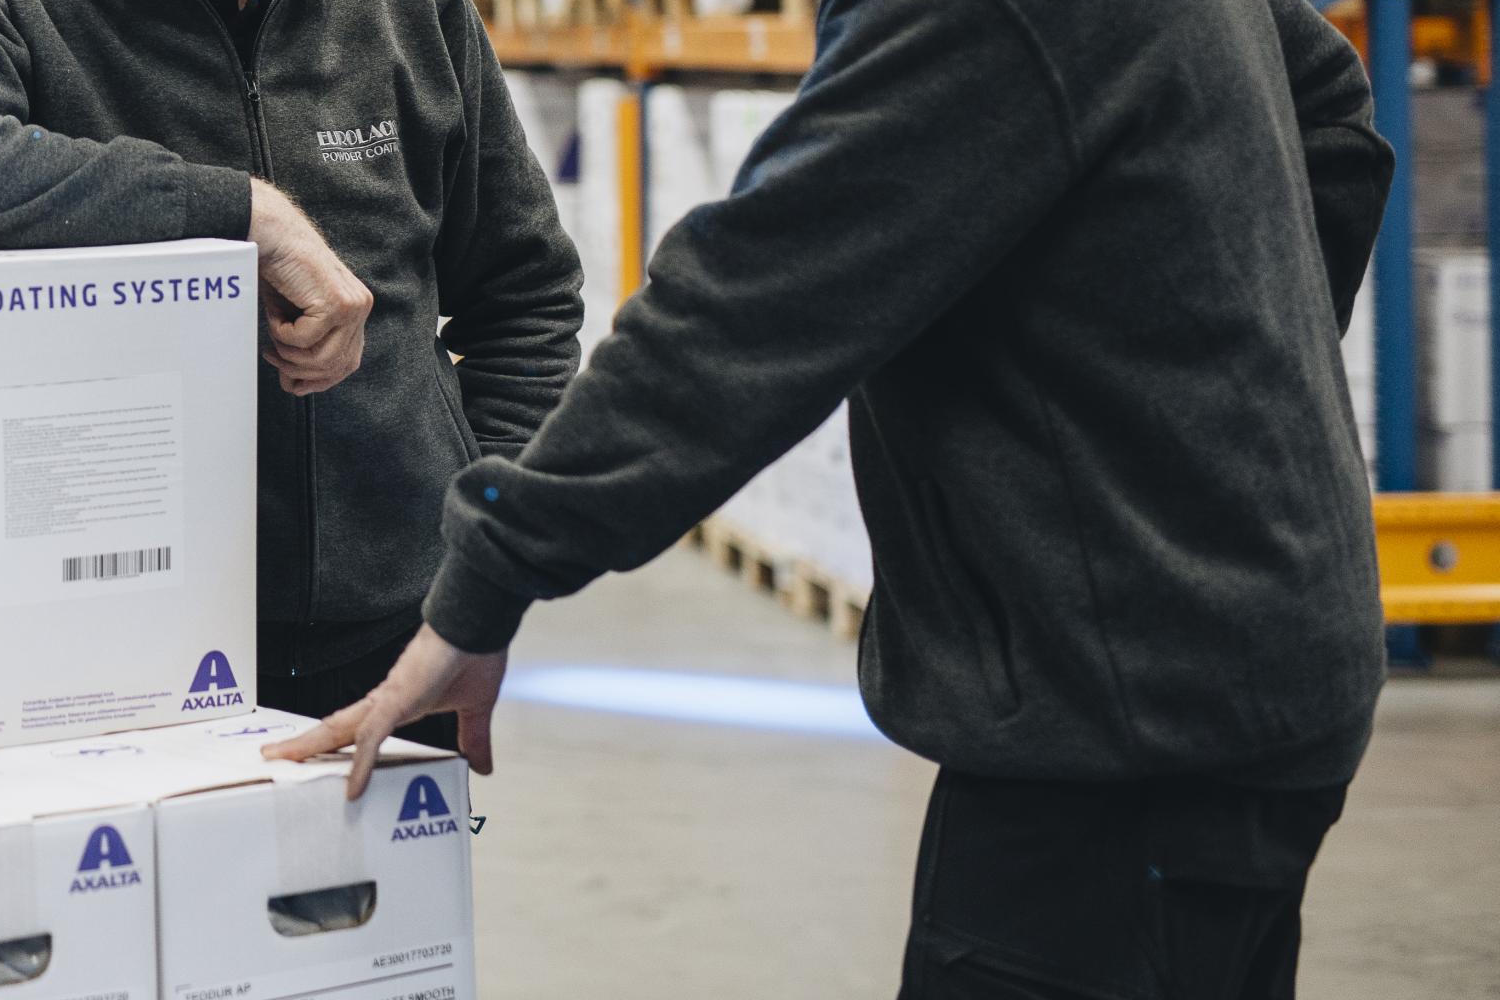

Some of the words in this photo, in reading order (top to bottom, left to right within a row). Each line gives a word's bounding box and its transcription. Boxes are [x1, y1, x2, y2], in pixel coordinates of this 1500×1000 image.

[322, 150, 362, 162] POWDER
[112, 275, 241, 306] SYSTEMS
[181, 692, 244, 712] AXALTA
[391, 818, 458, 843] AXALTA
[69, 870, 141, 894] AXALTA
